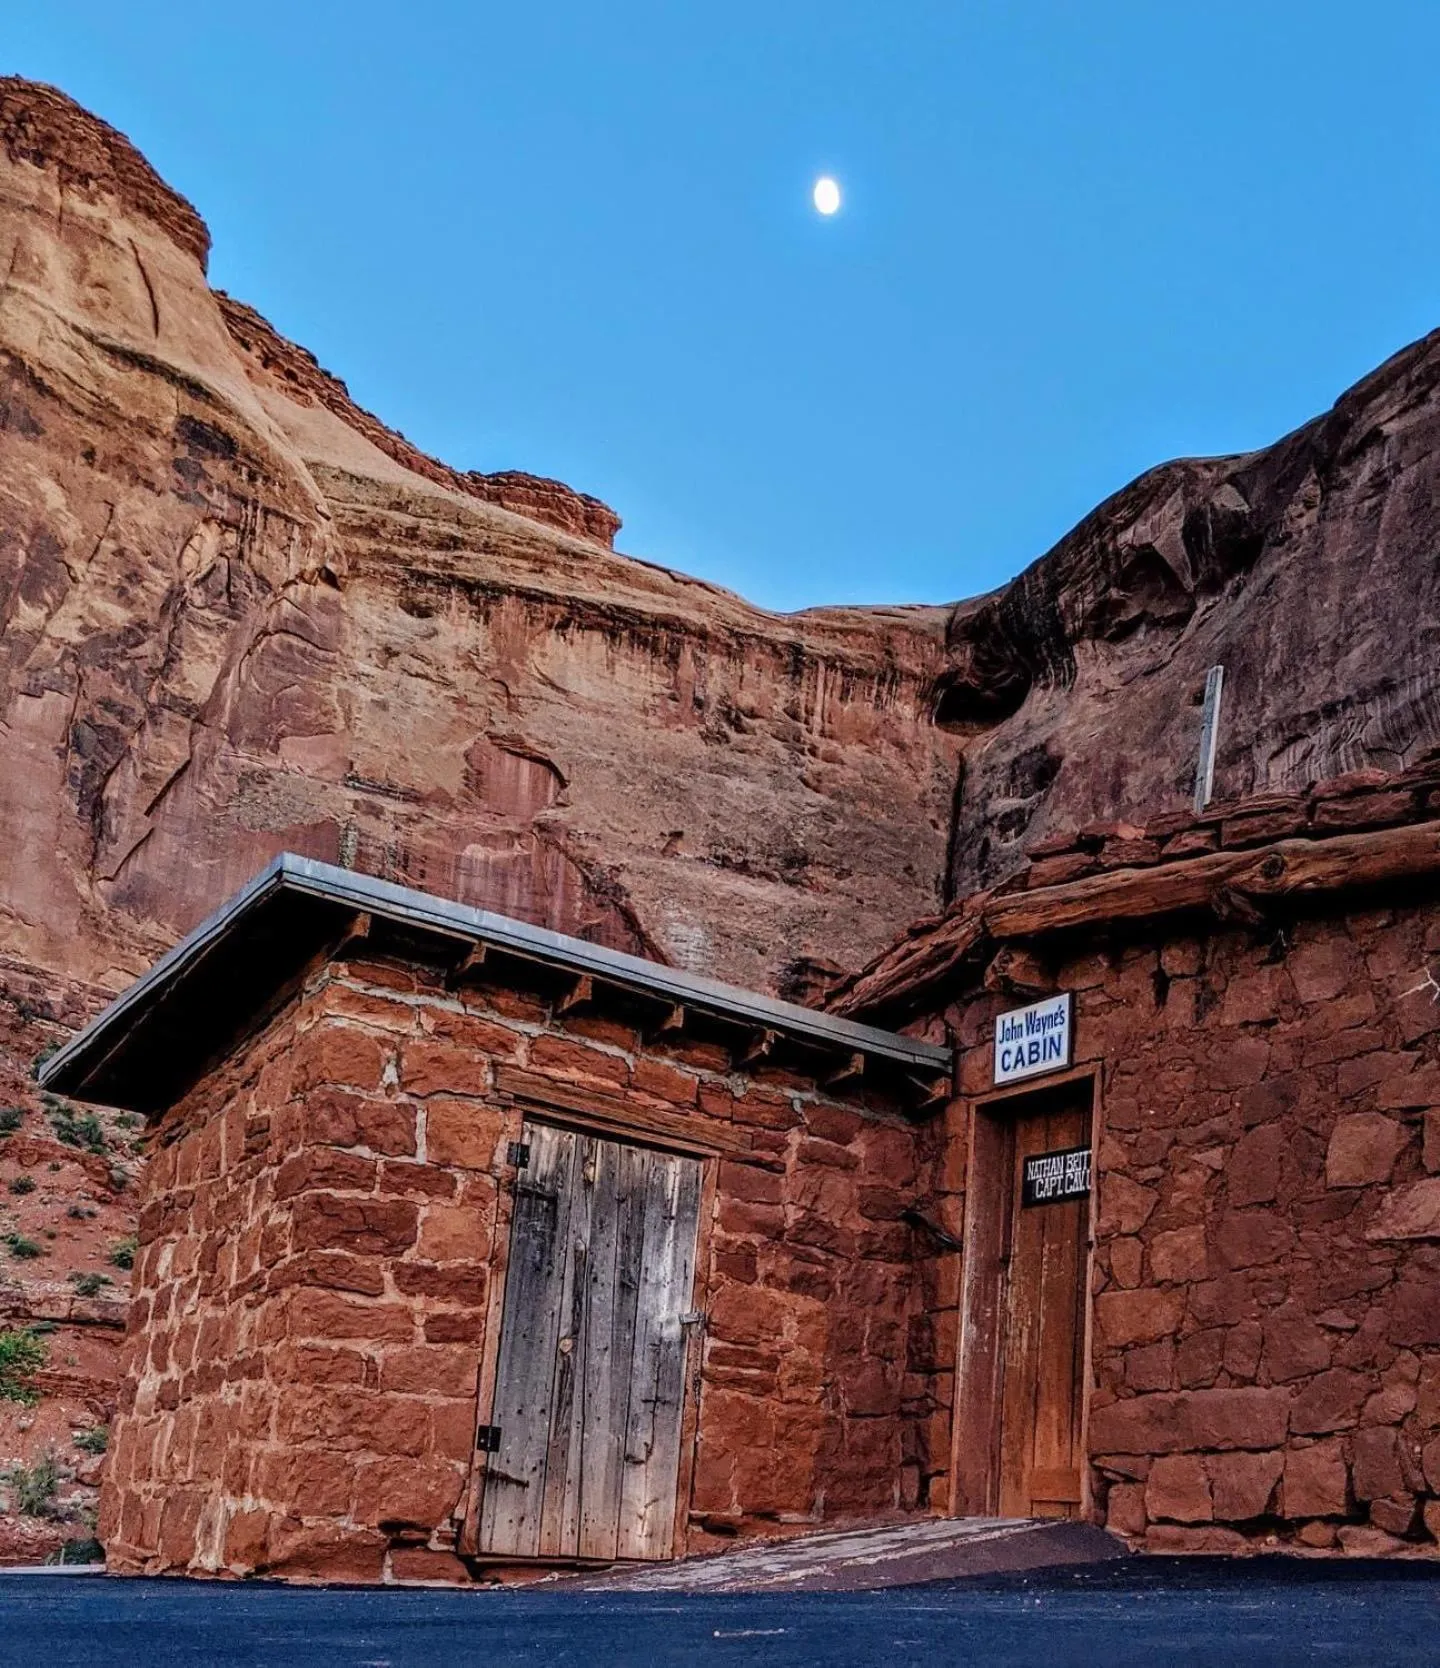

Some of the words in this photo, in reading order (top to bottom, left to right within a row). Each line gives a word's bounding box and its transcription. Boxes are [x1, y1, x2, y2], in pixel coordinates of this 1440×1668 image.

[999, 1016, 1023, 1044] John
[1025, 1004, 1065, 1036] Wayne's
[1001, 1034, 1062, 1072] CABIN
[1027, 1155, 1064, 1180] NATHAN
